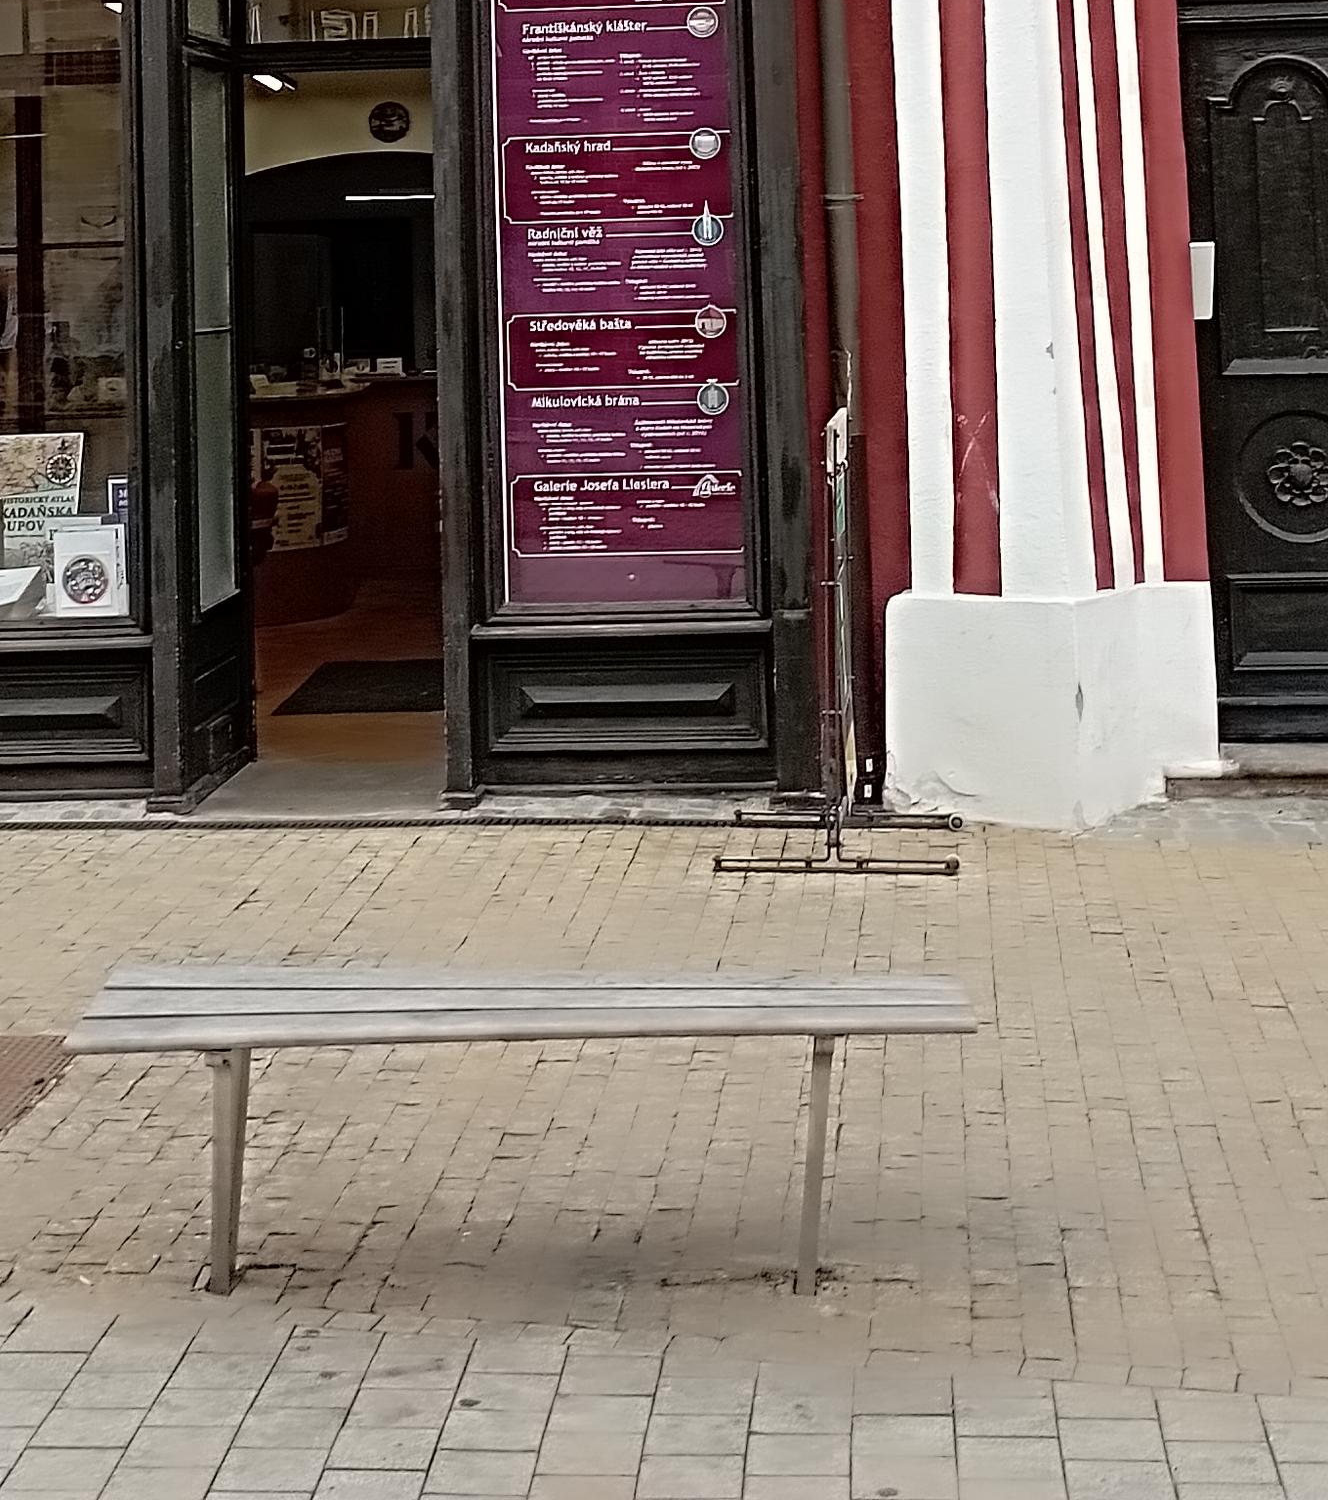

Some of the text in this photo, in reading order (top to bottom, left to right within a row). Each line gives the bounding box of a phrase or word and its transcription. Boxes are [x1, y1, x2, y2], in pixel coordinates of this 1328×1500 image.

[606, 20, 647, 33] klášter
[525, 140, 611, 154] Kadaňský hrad
[582, 227, 603, 239] věž
[529, 318, 631, 332] Středověká bašta
[531, 394, 640, 408] Mikulovická brána
[534, 480, 577, 492] Galerie
[580, 479, 619, 492] Josefa
